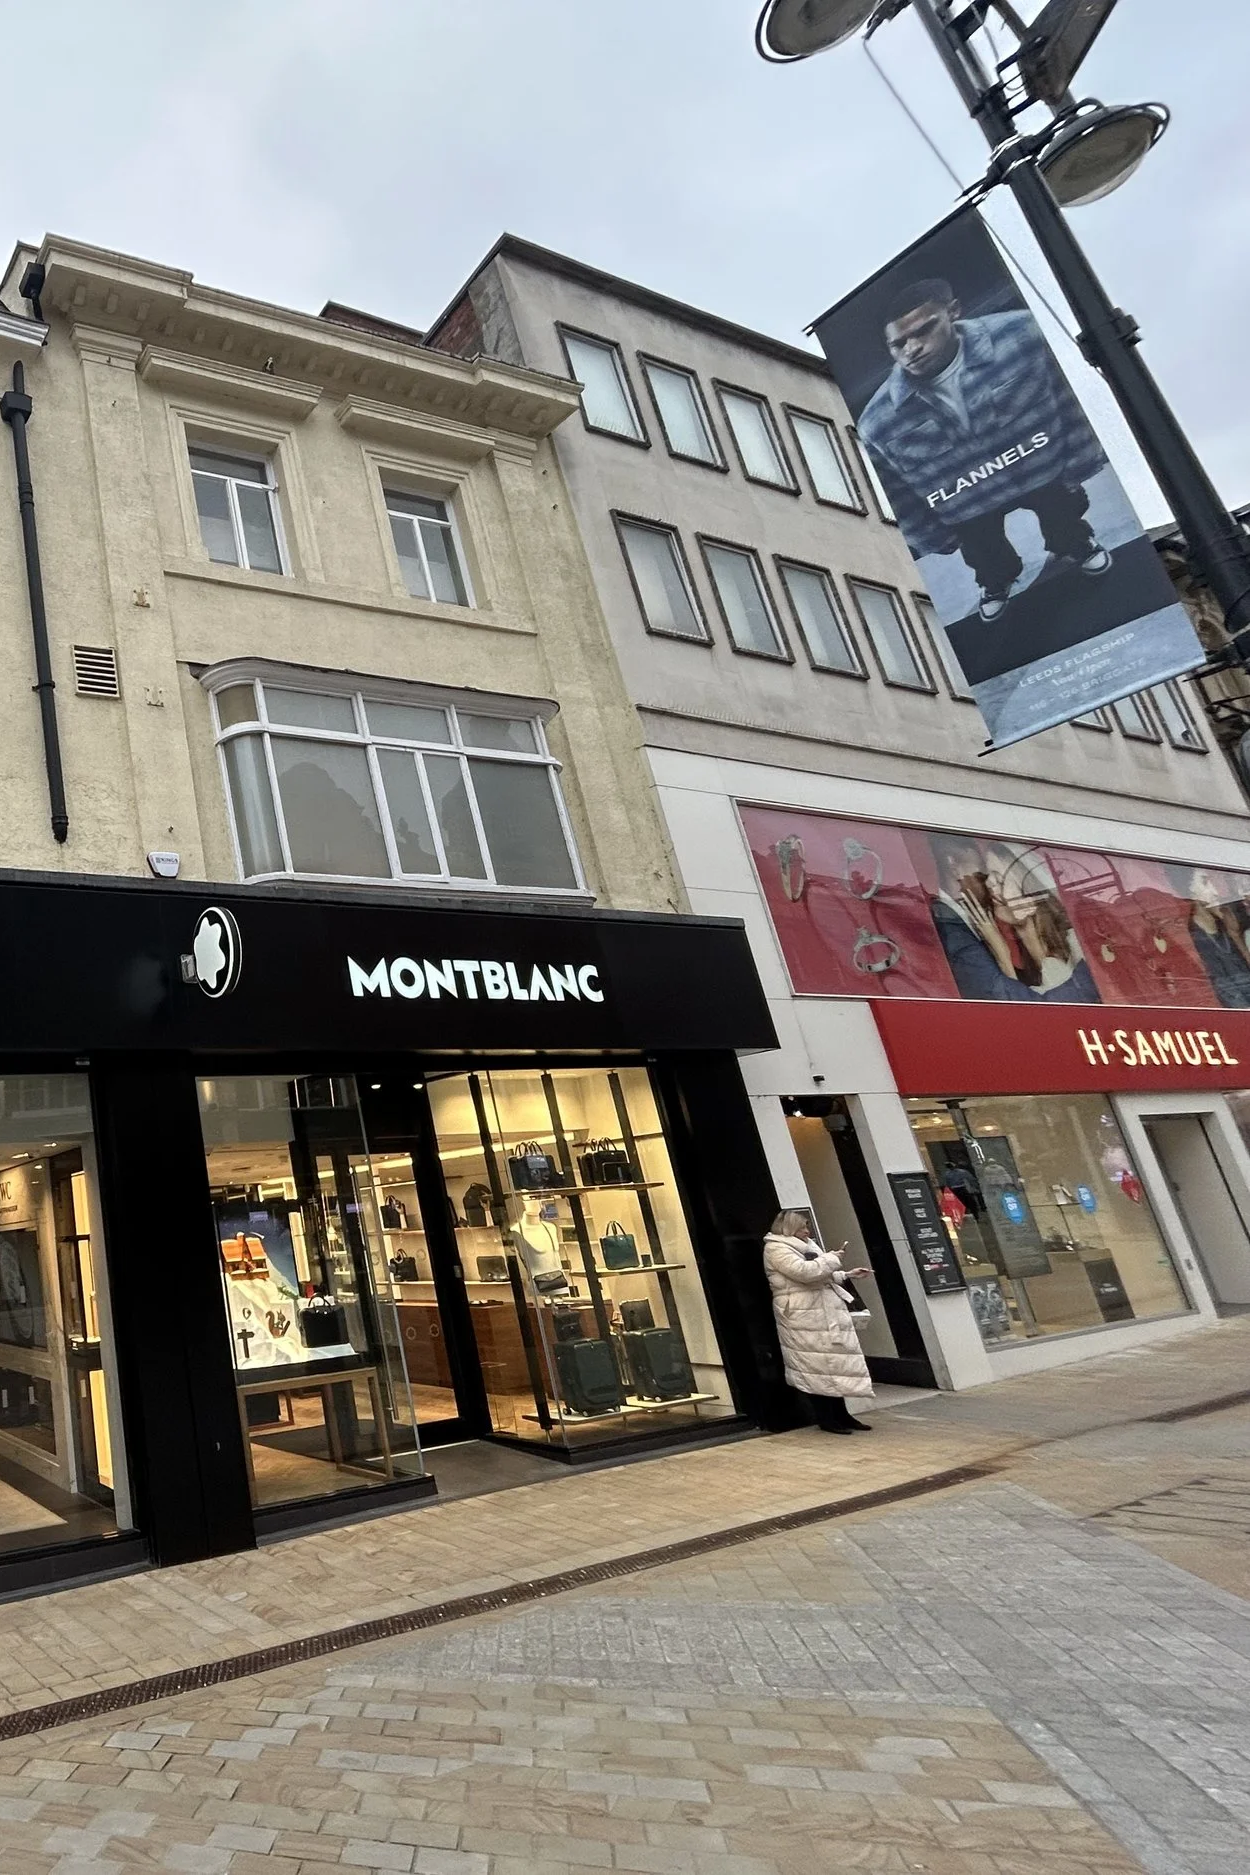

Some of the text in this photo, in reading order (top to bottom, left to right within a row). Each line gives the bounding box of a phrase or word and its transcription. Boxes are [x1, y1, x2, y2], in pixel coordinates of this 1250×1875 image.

[926, 432, 1049, 508] FLANNELS
[1019, 632, 1135, 688] LEEDS FLAGSHIP
[1081, 657, 1147, 691] BRIGGATE
[347, 955, 605, 1003] MONTBLANC
